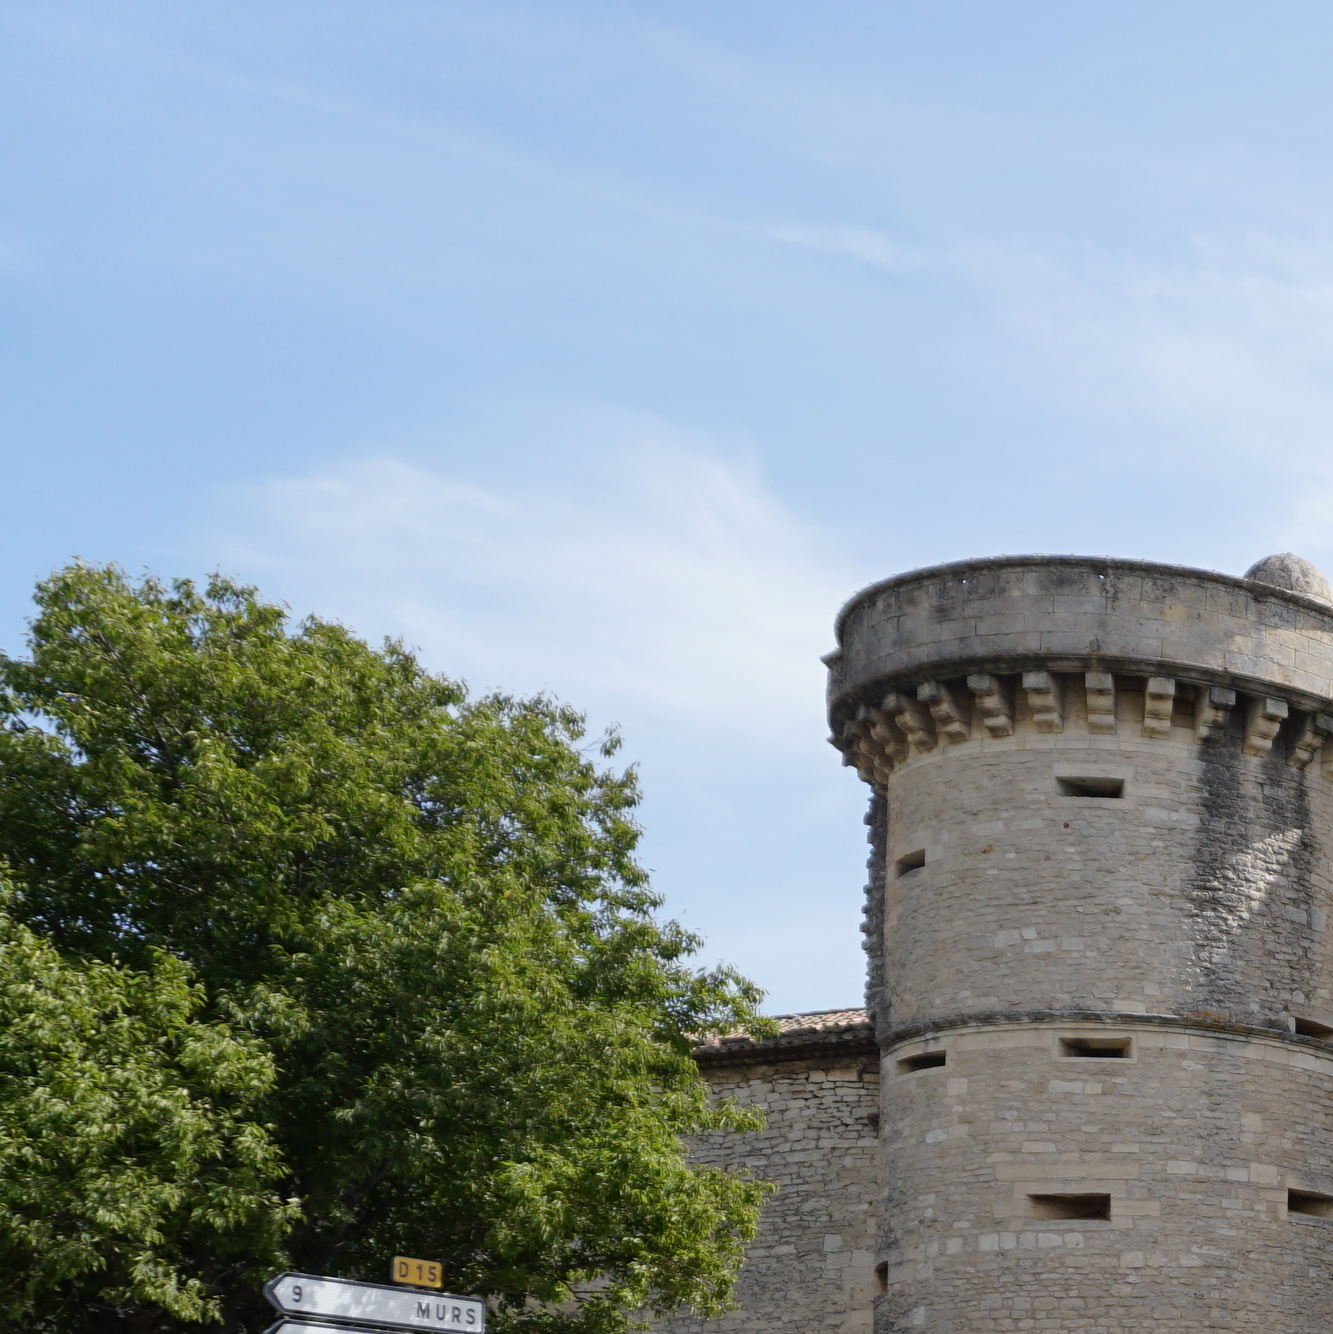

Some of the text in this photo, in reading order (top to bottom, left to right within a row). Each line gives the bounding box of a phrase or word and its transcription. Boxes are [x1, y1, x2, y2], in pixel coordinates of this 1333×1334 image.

[398, 1264, 438, 1282] D 15
[292, 1285, 303, 1303] 9
[416, 1301, 476, 1325] MURS
